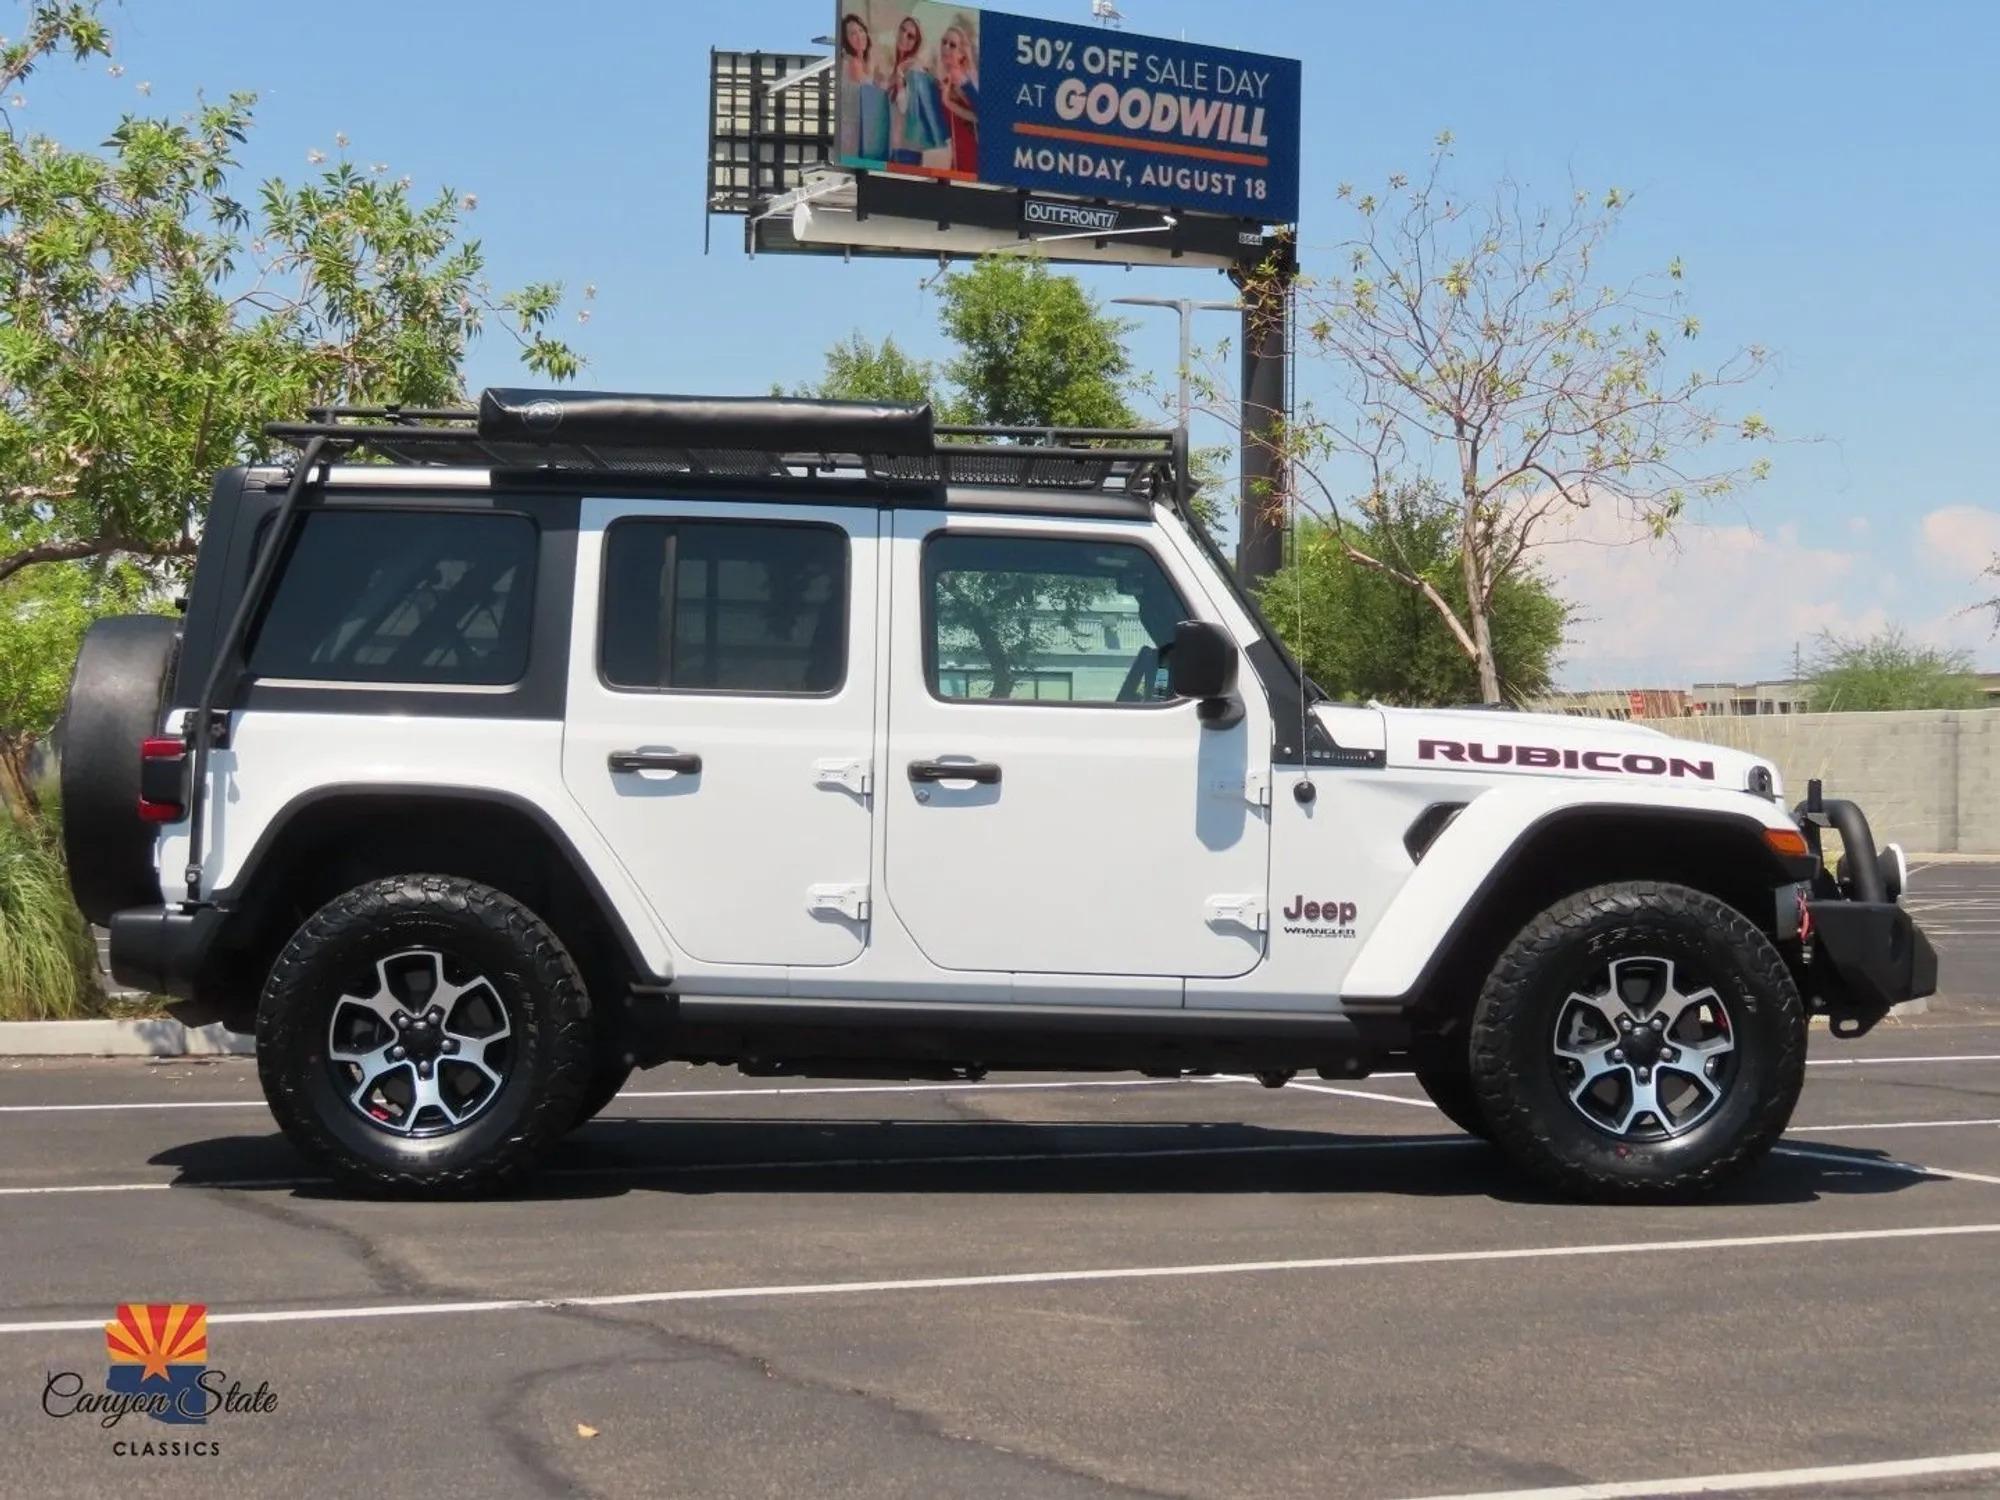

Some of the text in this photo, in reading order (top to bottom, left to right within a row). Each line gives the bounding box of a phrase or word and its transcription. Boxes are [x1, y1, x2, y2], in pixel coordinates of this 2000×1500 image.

[1016, 34, 1270, 99] 50% OFF SALE DAY
[1016, 78, 1268, 146] AT GOODWILL
[1013, 146, 1267, 200] MONDAY, AUGUST 18
[1418, 739, 1715, 781] RUBICON
[1283, 894, 1357, 926] Jeep
[1284, 926, 1355, 935] WRANGLER
